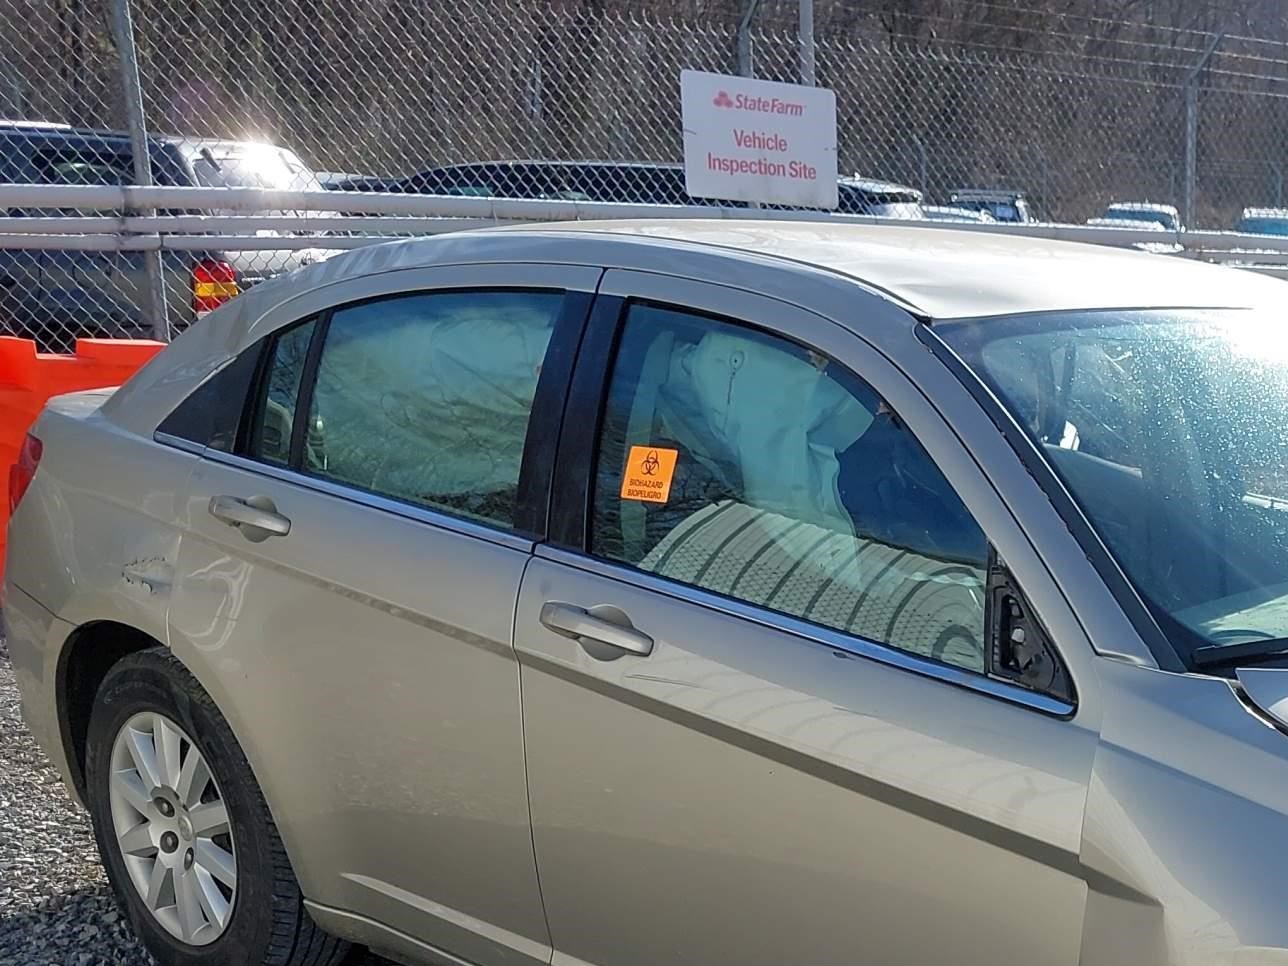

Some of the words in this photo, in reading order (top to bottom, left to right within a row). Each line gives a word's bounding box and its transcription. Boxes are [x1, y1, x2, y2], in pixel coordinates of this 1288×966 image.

[733, 128, 788, 151] Vehicle
[707, 152, 786, 177] Inspection
[788, 160, 817, 180] Site
[629, 478, 664, 489] BIOHAZARD
[627, 488, 662, 500] BIOPELIGRO
